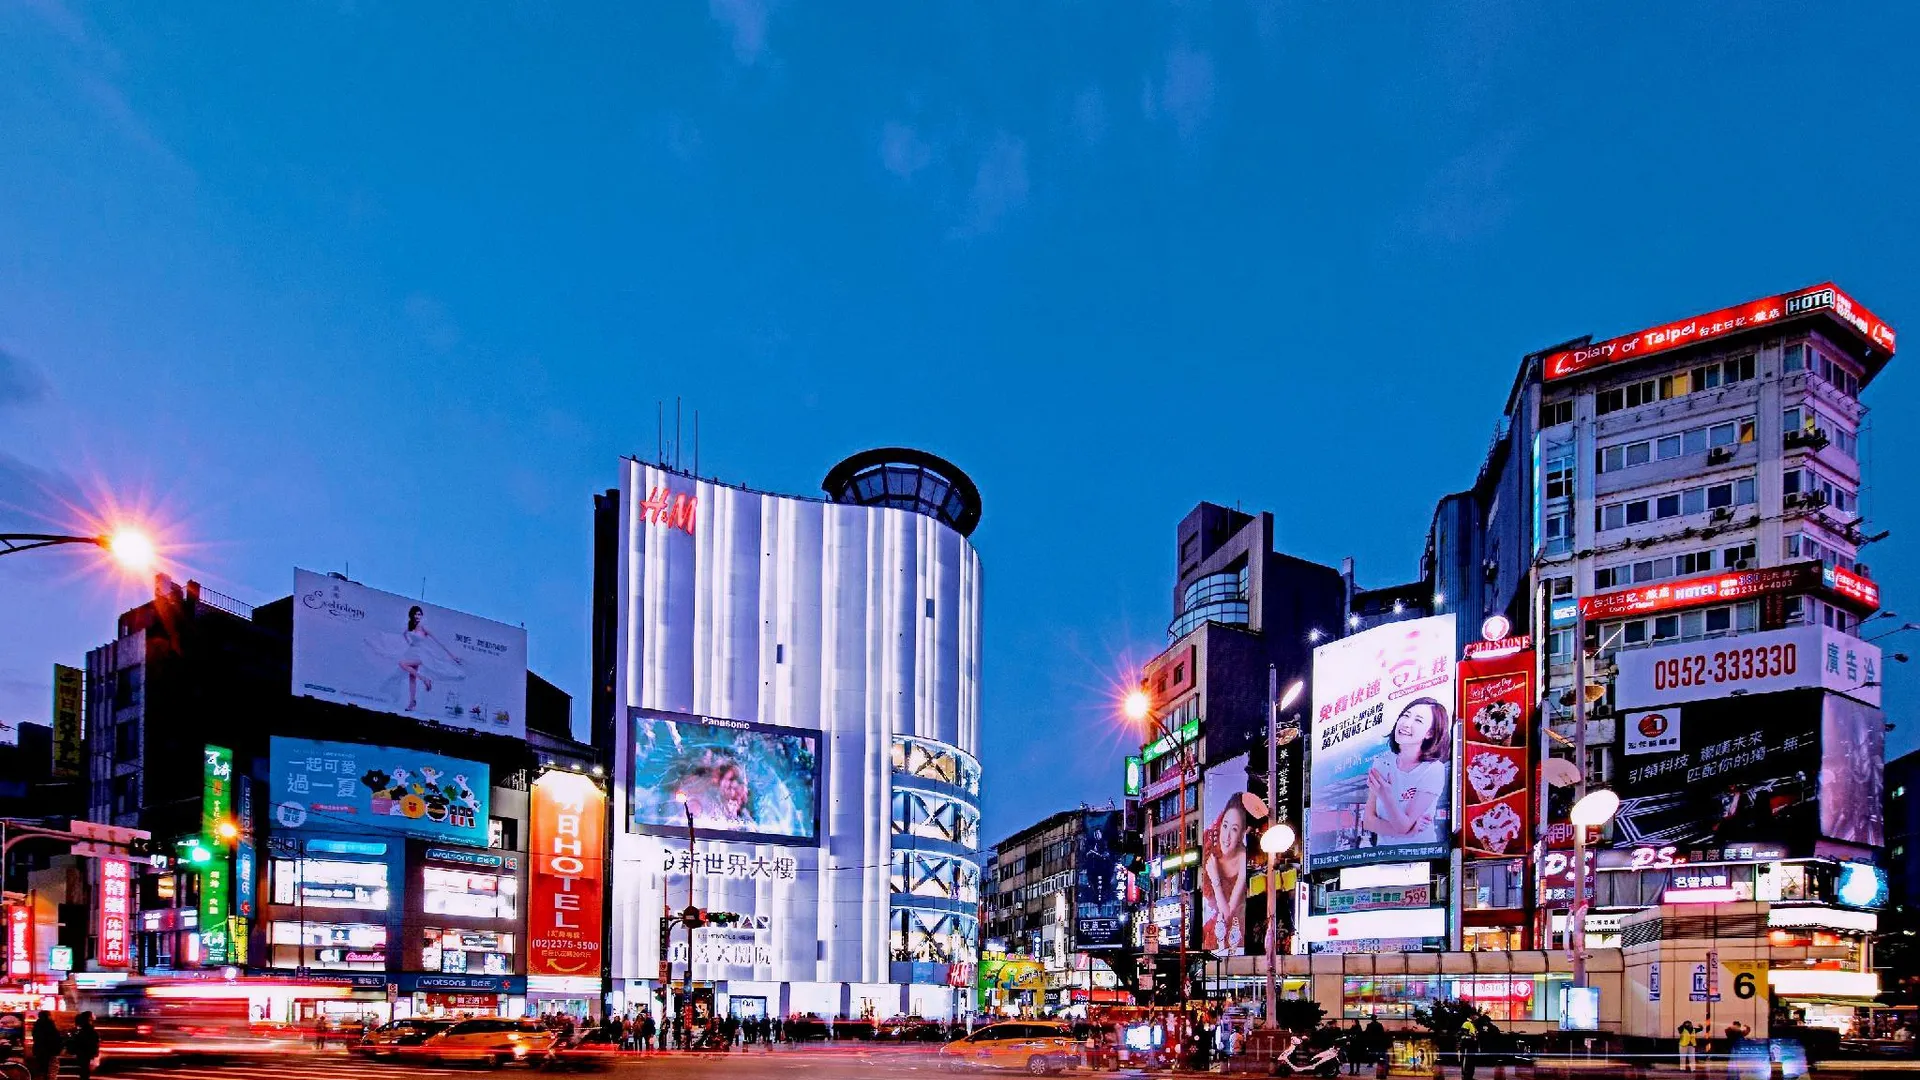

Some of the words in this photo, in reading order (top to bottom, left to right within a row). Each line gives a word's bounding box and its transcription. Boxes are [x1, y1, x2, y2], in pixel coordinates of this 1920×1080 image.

[1574, 342, 1617, 363] Diary
[1621, 337, 1640, 353] of
[1644, 321, 1696, 346] Taipei
[640, 486, 698, 536] H&M
[1675, 584, 1717, 600] HOTEL
[1464, 641, 1493, 656] COLD
[1494, 635, 1530, 651] STONE
[702, 716, 750, 730] Panasonic
[288, 756, 357, 776] 一起可愛
[1628, 753, 1690, 784] 引領科技
[286, 772, 358, 798] 過一夏
[432, 851, 473, 862] watsons
[550, 837, 583, 928] HOTEL
[423, 979, 467, 987] watsons
[1733, 971, 1757, 1000] 6
